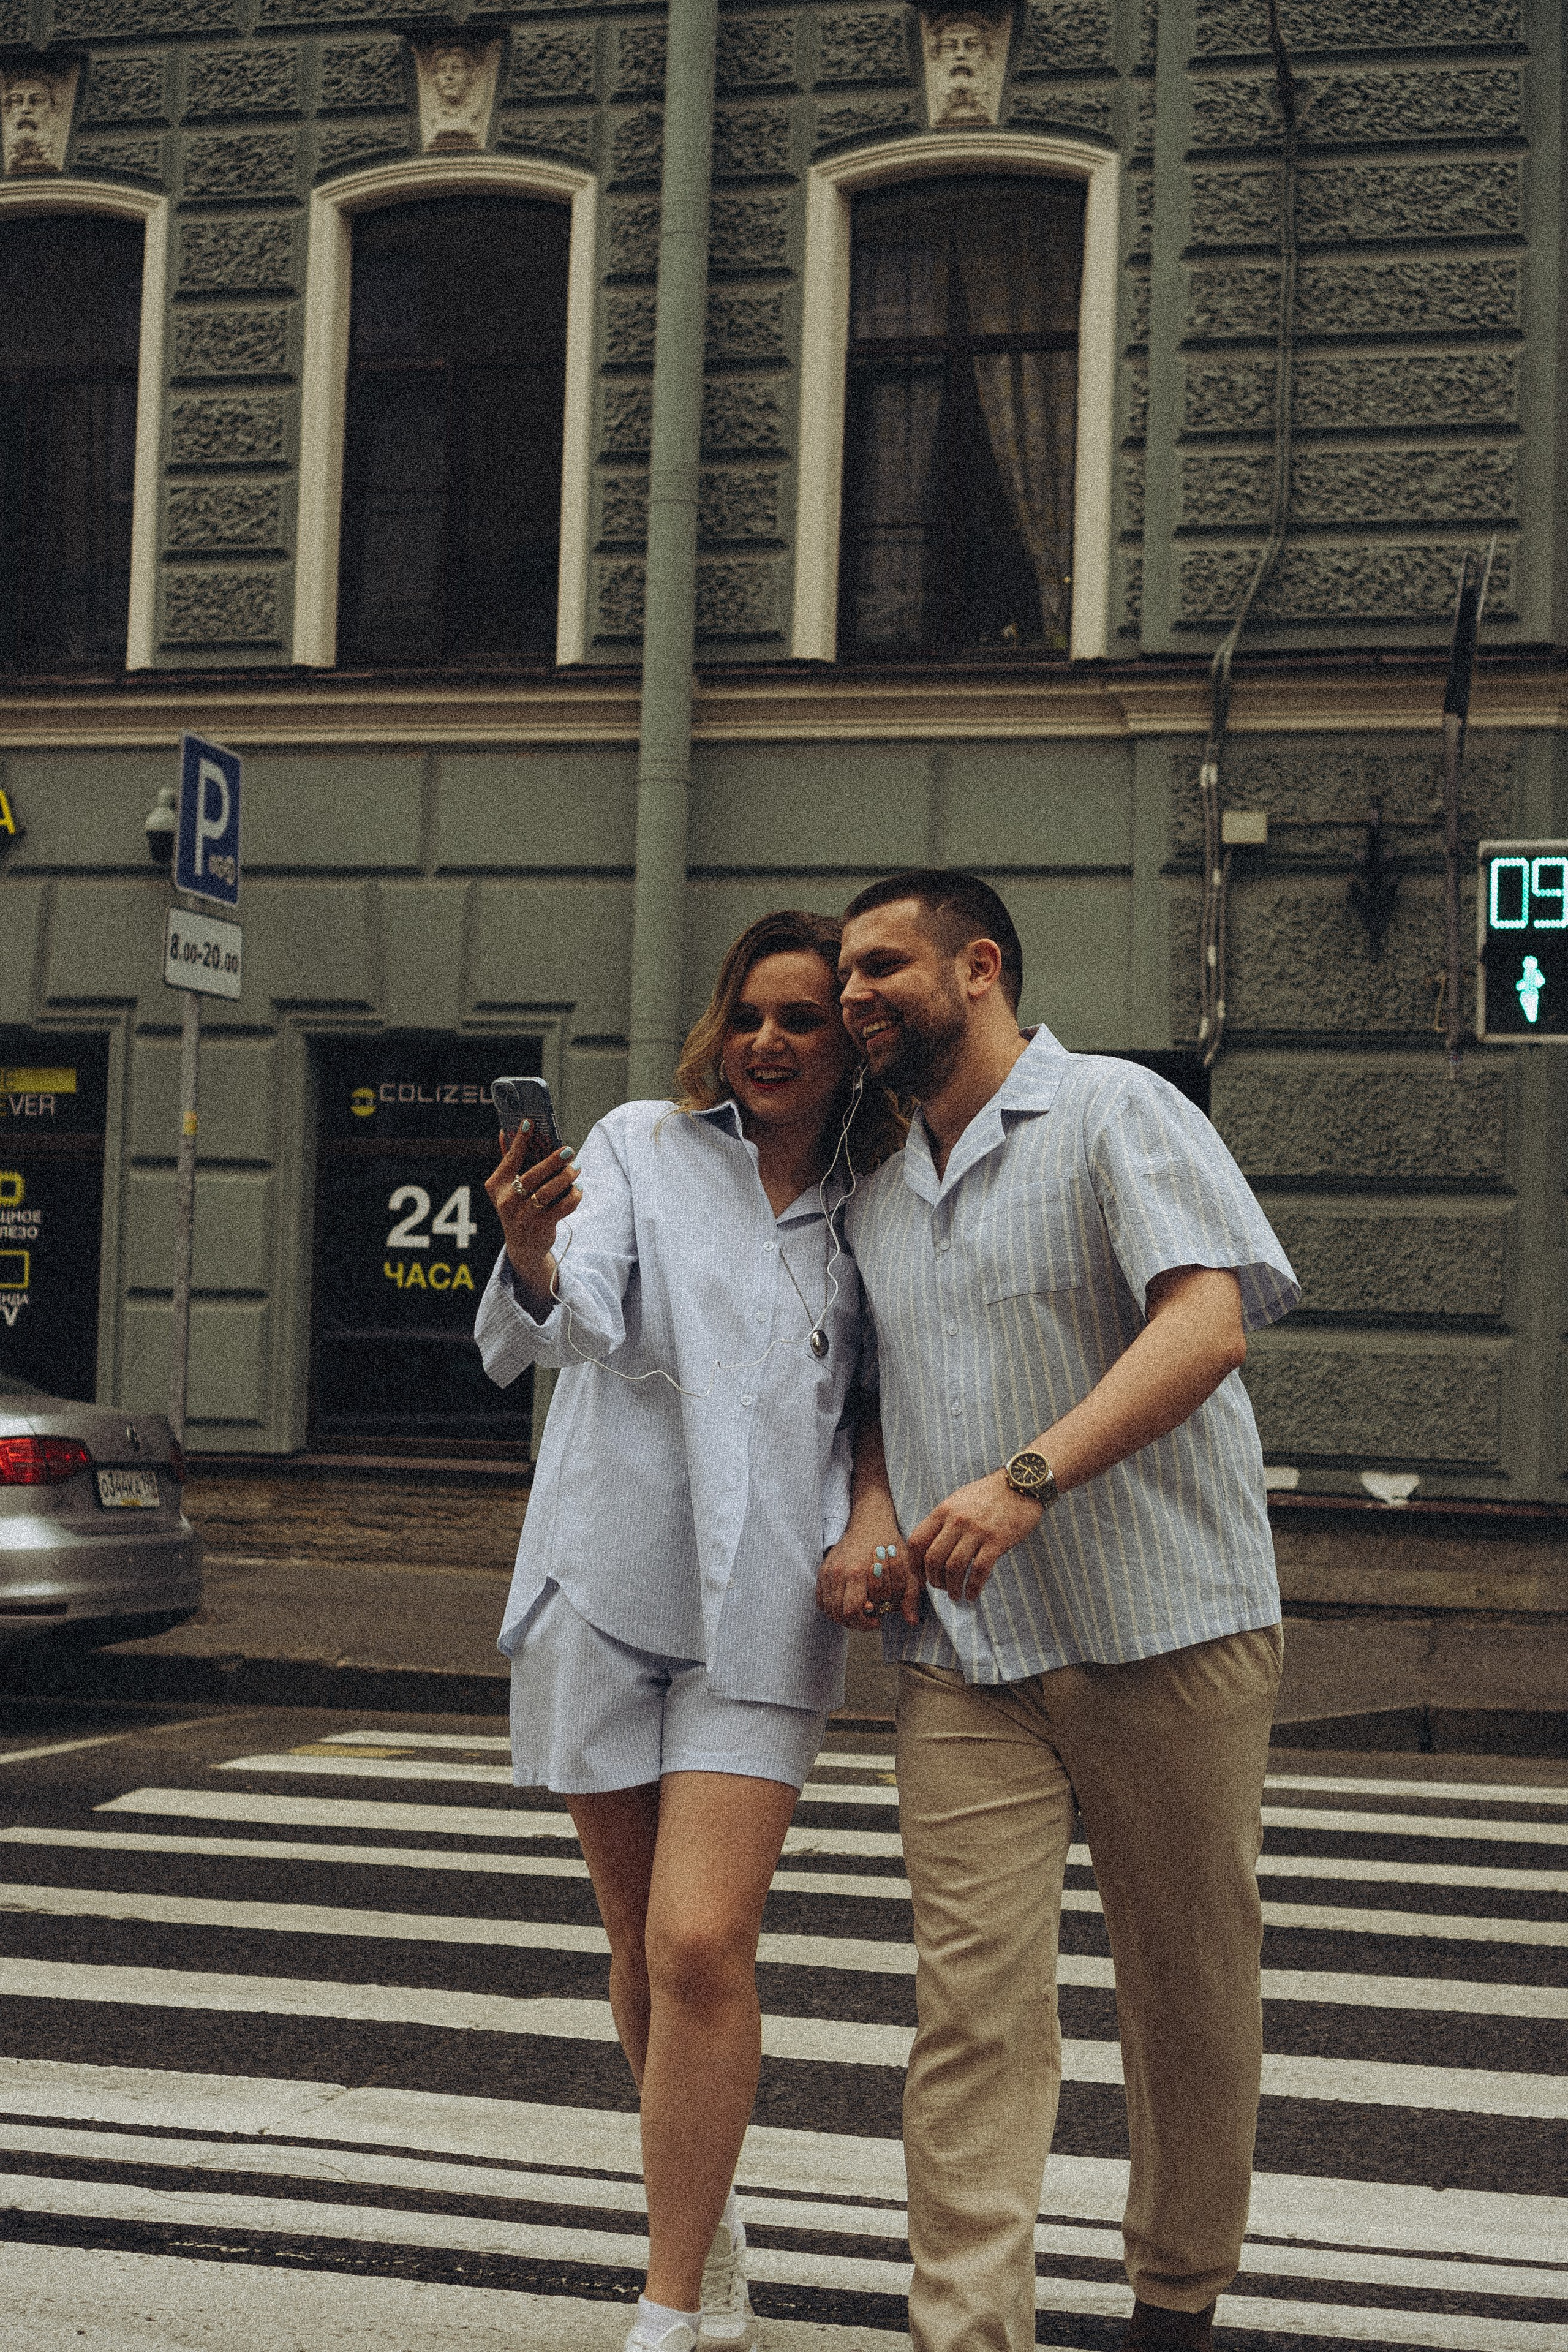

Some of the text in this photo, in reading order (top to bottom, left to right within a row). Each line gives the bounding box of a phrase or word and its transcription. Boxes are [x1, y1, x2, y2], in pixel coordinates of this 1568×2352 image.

[195, 758, 230, 876] P
[1490, 858, 1568, 929] 09
[170, 933, 238, 973] 8.00-20.00
[386, 1185, 478, 1249] 24
[384, 1262, 475, 1290] ЧАСА
